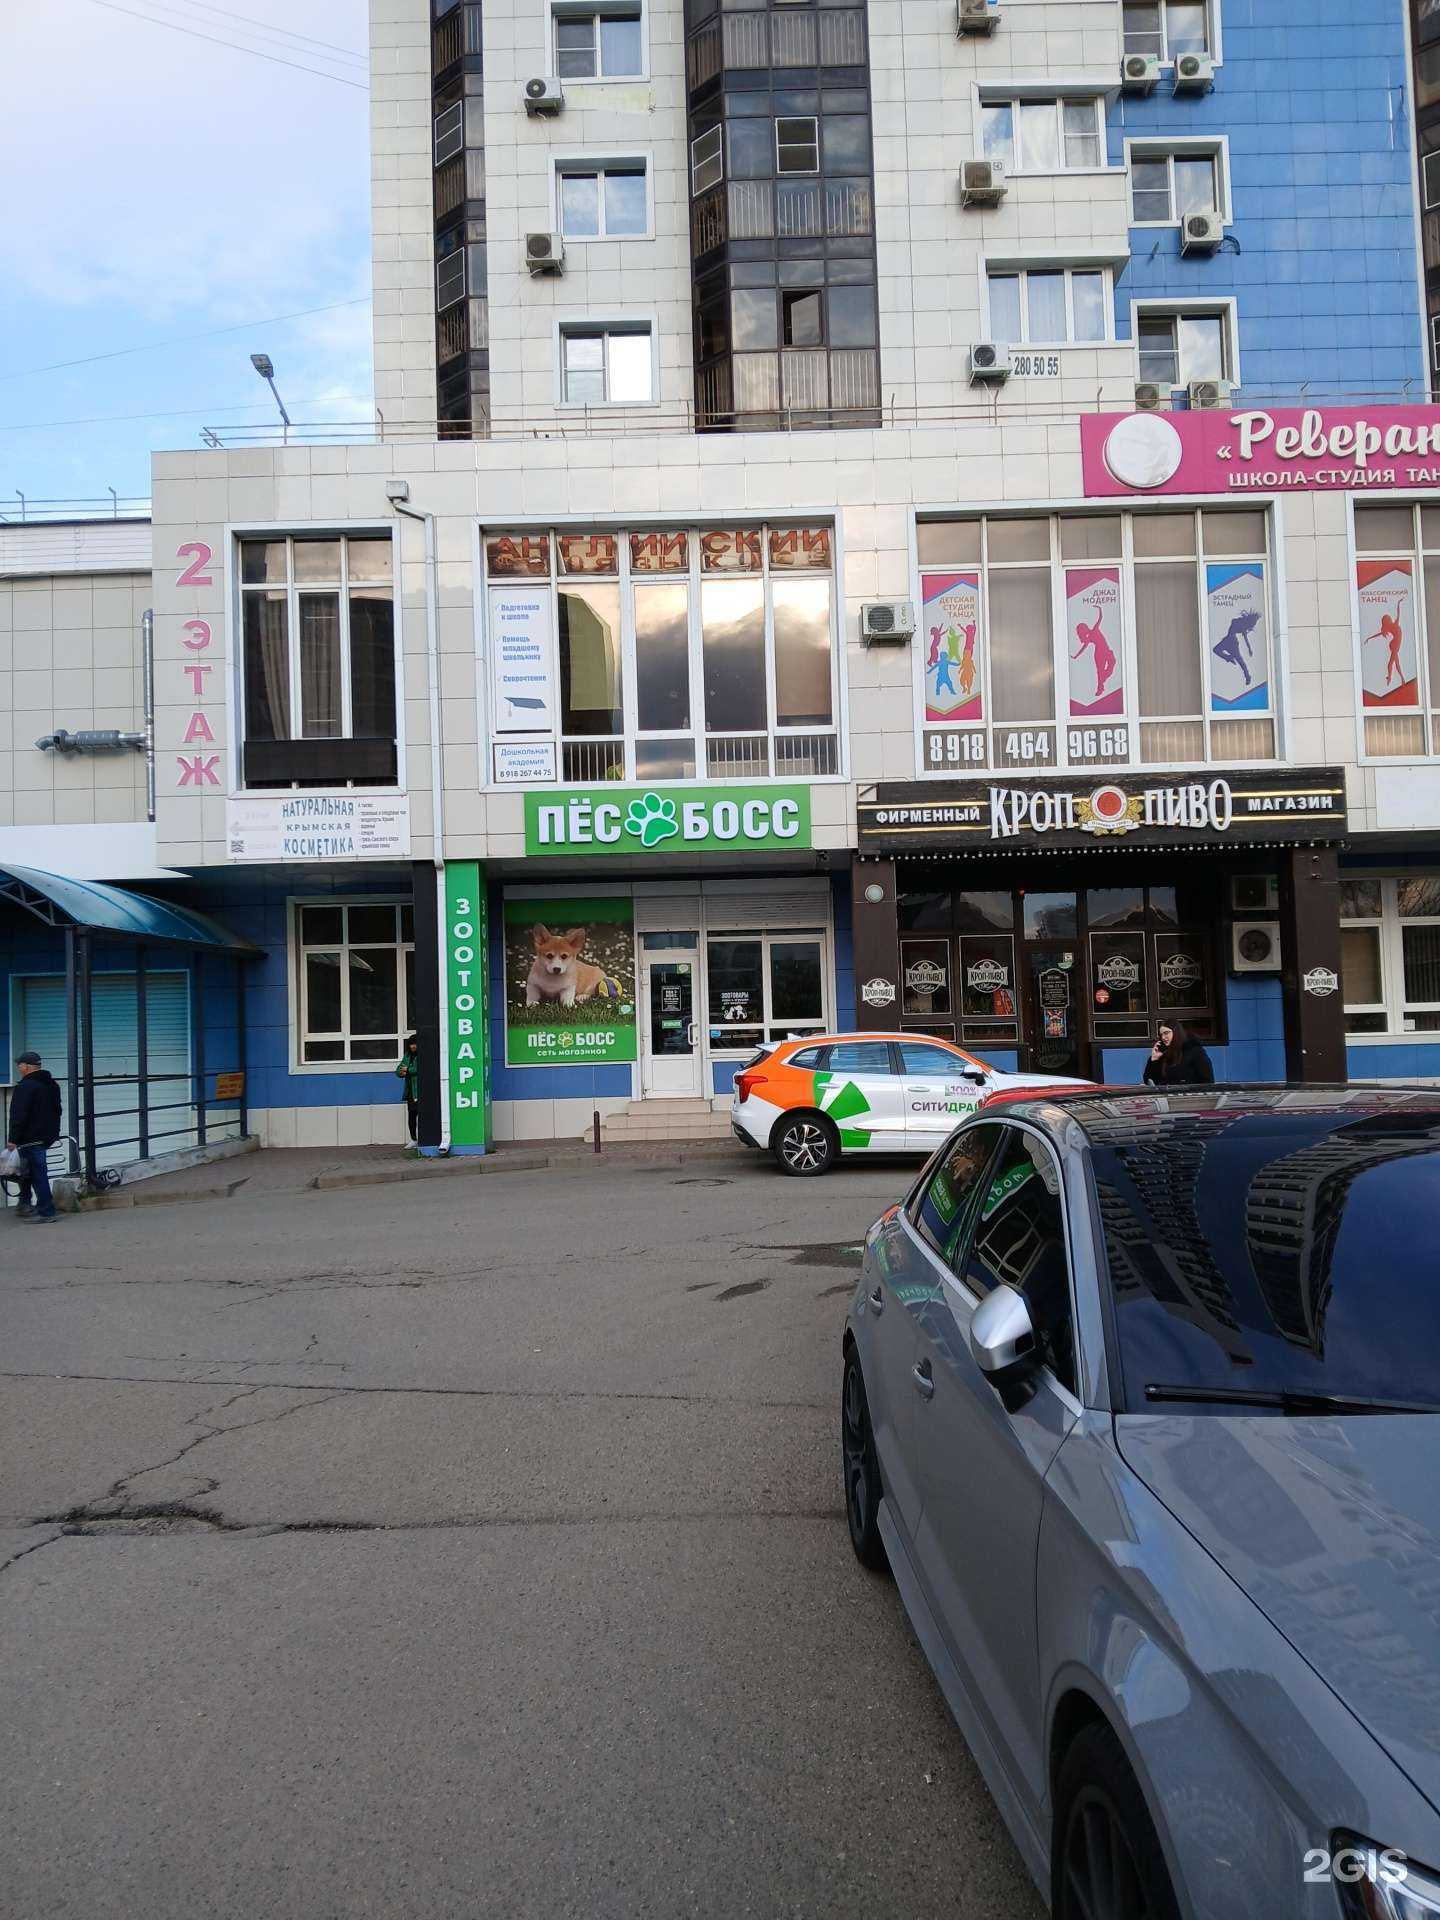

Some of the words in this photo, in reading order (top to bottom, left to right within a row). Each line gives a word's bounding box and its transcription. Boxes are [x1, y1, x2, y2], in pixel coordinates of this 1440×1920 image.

[1014, 356, 1031, 376] 280
[1033, 356, 1045, 376] 50
[1047, 356, 1059, 376] 55
[1229, 468, 1396, 487] ШКОЛА-СТУДИЯ
[176, 542, 215, 587] 2
[939, 596, 975, 604] ДЕТСКАЯ
[1082, 597, 1117, 605] МОДЕРН
[1092, 589, 1116, 597] ДЖАЗ
[1213, 592, 1252, 600] ЭСТРАДНЫЙ
[1361, 596, 1388, 604] ТАНЕЦ
[502, 635, 531, 643] Помощь
[176, 619, 221, 787] ЭТАЖ
[929, 734, 943, 762] 8
[946, 733, 985, 761] 918
[1005, 731, 1050, 760] 464
[1069, 730, 1097, 758] 96
[1100, 728, 1128, 756] 68
[500, 748, 549, 757] Дошкольная
[508, 759, 545, 767] академия
[543, 768, 552, 776] 75
[282, 798, 354, 818] НАТУРАЛЬНАЯ
[876, 806, 981, 824] ФИРМЕННЫЙ
[989, 787, 1075, 840] КРОП
[1144, 778, 1233, 832] ПИВО
[1248, 796, 1333, 812] МАГАЗИН
[286, 822, 352, 832] КРЫМСКАЯ
[538, 797, 622, 844] ПЁС
[683, 799, 800, 840] БОСС
[283, 837, 355, 857] КОСМЕТИКА
[453, 898, 479, 1109] ЗООТОВАРЫ
[527, 1031, 557, 1047] ПЁС
[575, 1031, 616, 1046] БОСС
[558, 1048, 607, 1057] магазинов
